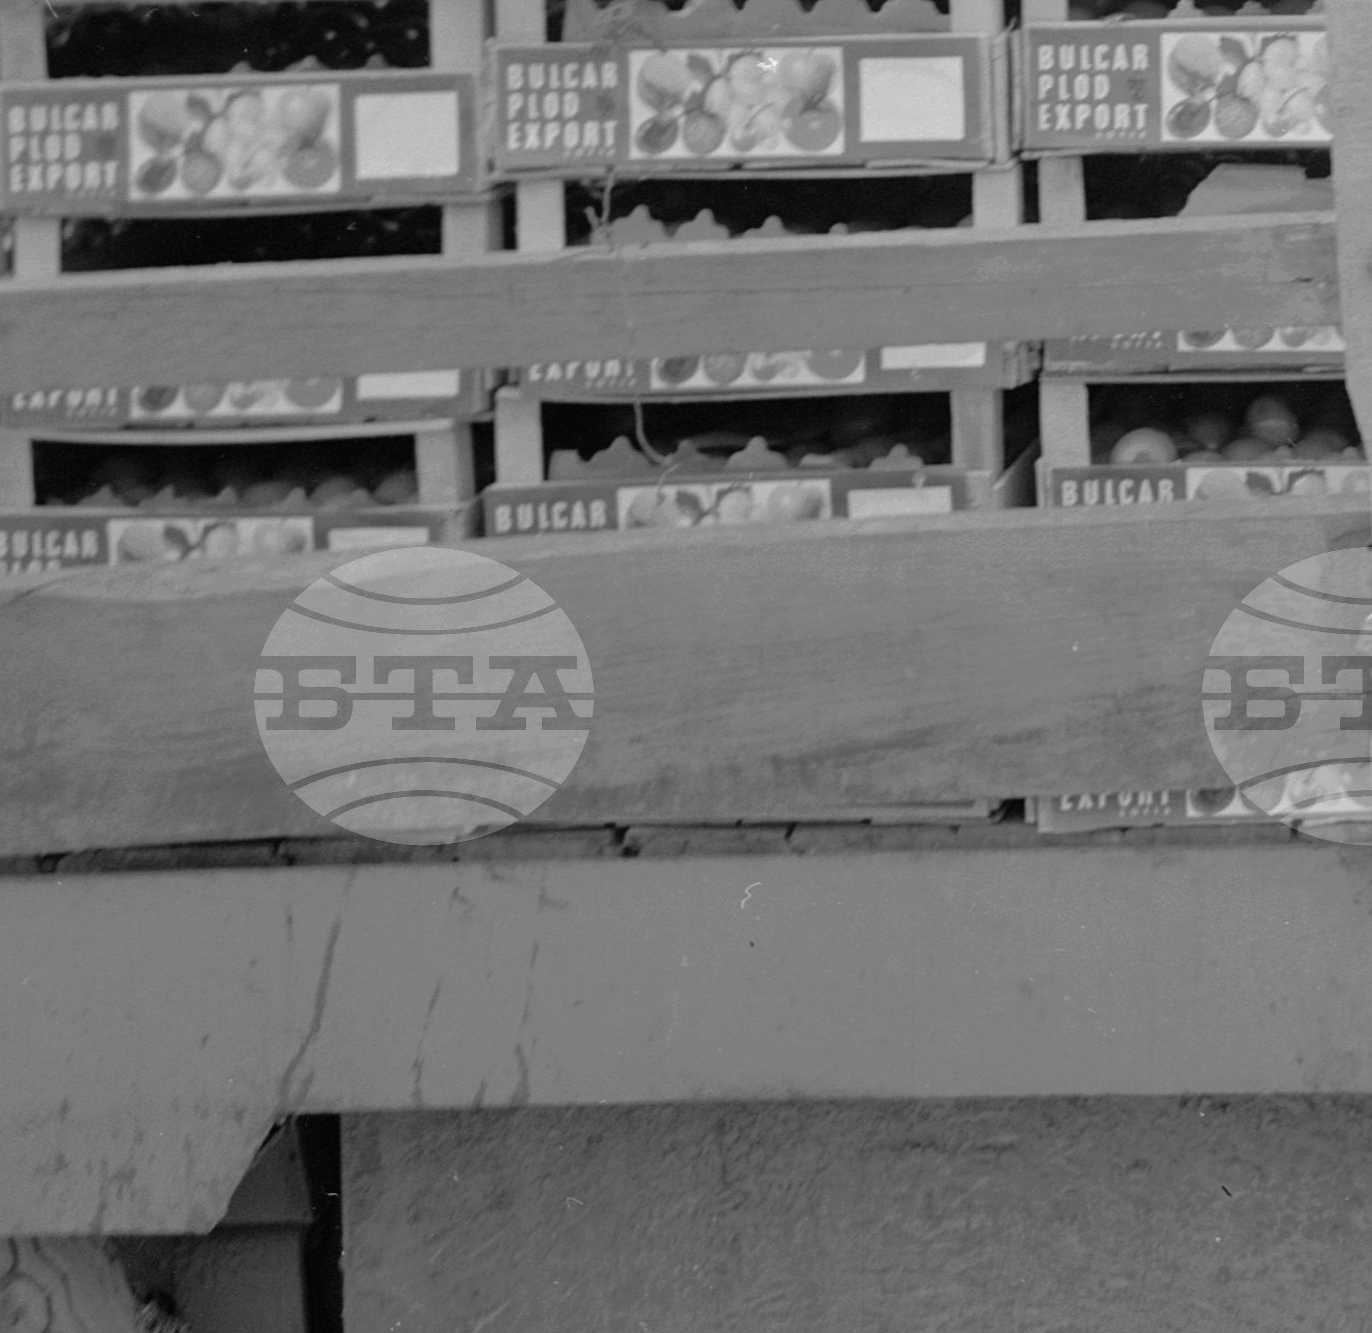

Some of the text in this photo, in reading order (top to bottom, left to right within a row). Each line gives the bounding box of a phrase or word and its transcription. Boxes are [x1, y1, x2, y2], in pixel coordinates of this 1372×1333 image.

[1038, 73, 1110, 100] PLOD
[507, 91, 580, 119] PLOD
[1038, 102, 1149, 131] EXPORT
[507, 119, 618, 151] EXPORT
